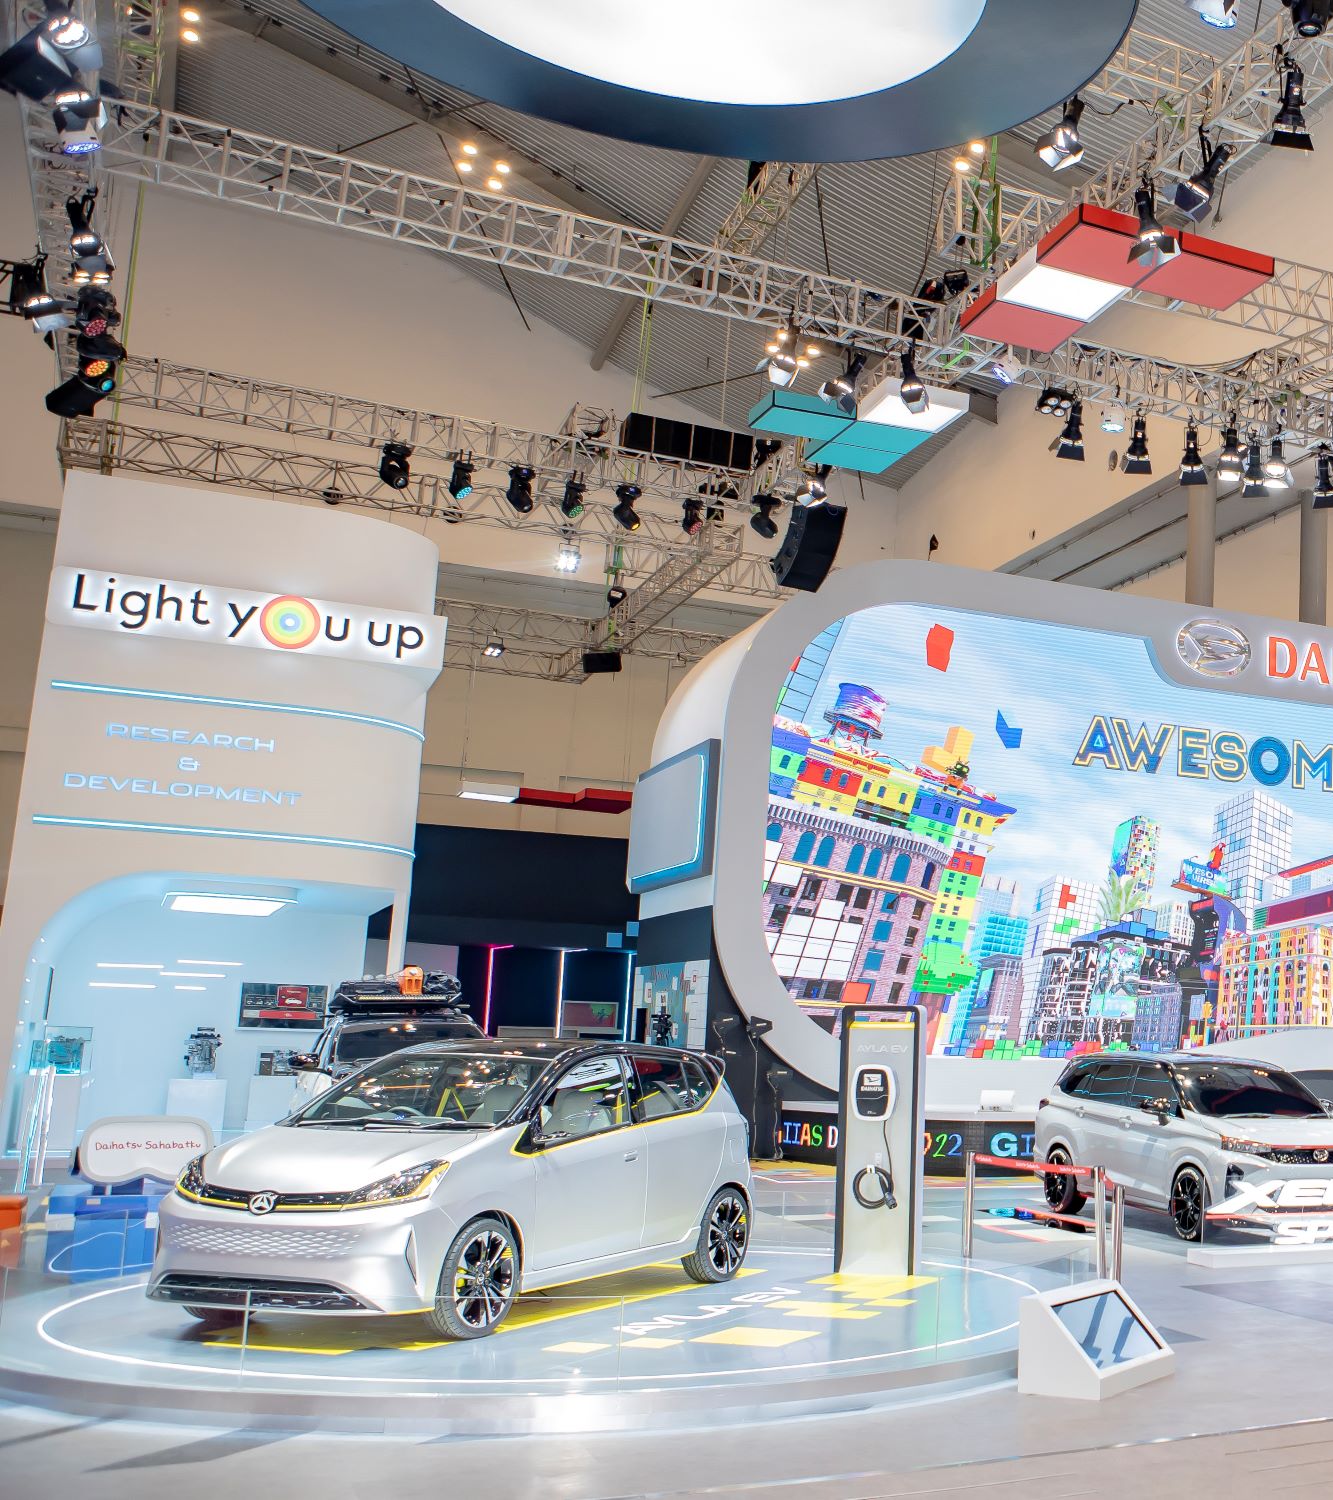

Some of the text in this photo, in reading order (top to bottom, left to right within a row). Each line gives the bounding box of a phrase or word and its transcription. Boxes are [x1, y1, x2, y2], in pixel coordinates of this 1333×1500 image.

[72, 573, 211, 631] Light
[367, 620, 424, 659] up
[107, 722, 276, 753] RESEARCH
[177, 756, 201, 772] &
[63, 772, 304, 806] DEVELOPMENT
[890, 1044, 909, 1054] EV
[95, 1140, 201, 1151] Daihatsu Sahabatku
[613, 1286, 802, 1336] AYLA EV
